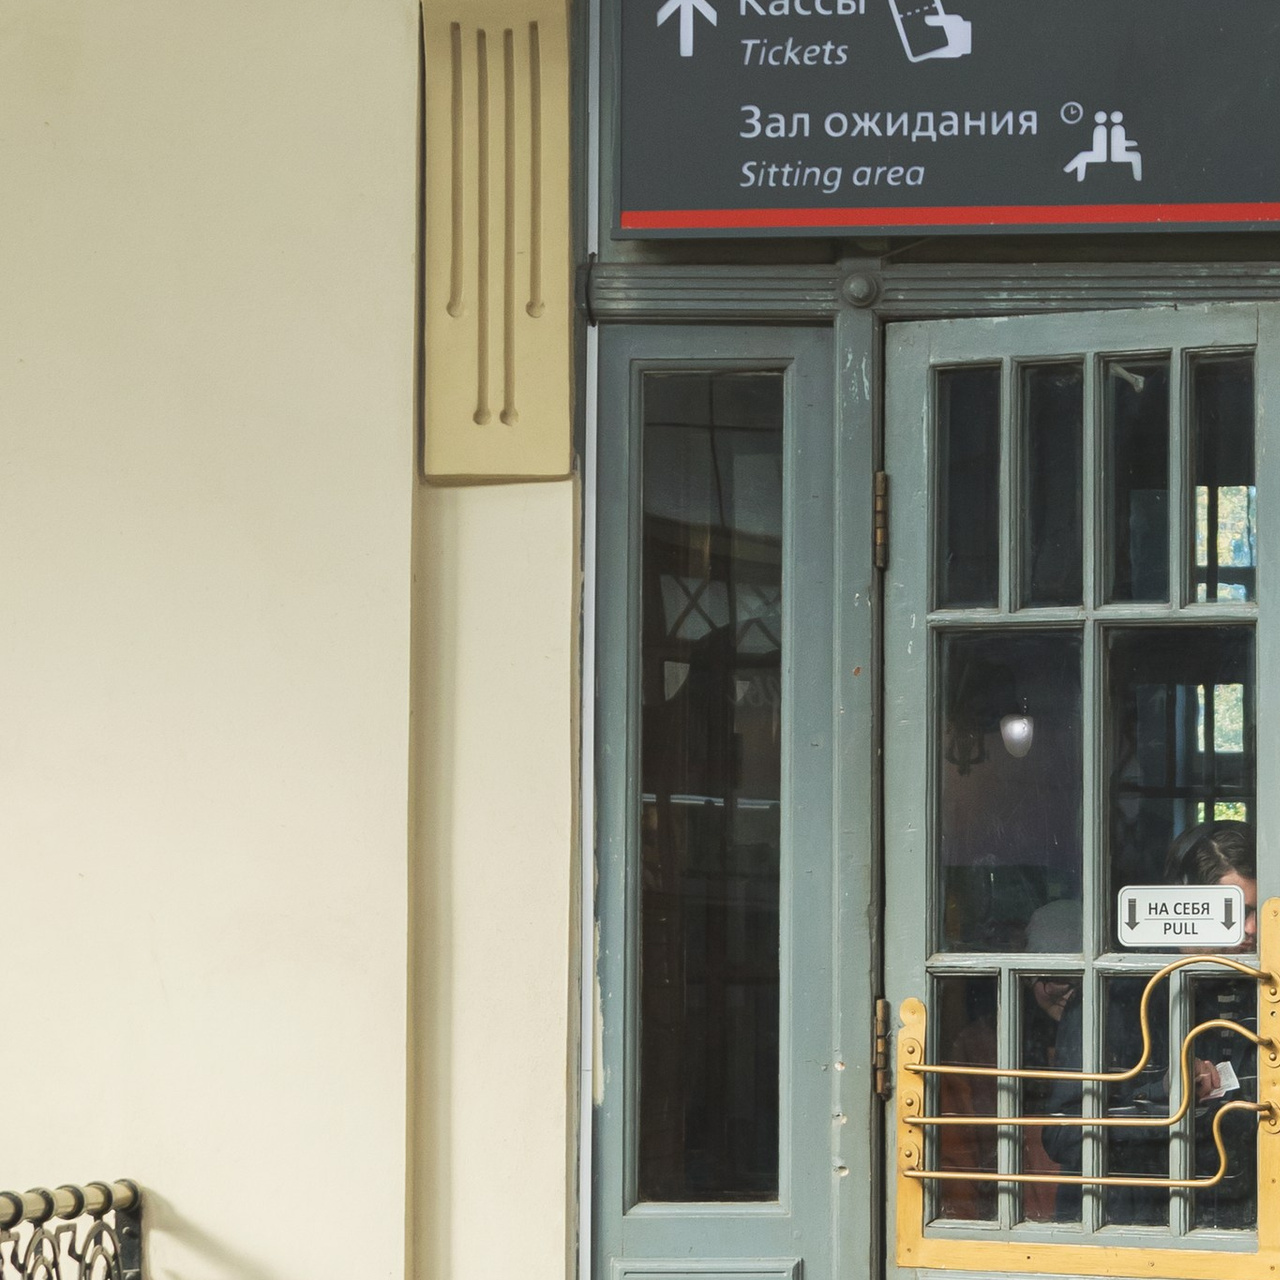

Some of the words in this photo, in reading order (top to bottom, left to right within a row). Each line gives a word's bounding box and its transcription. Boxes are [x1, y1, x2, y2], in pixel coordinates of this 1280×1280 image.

[739, 37, 849, 66] Tickets
[739, 104, 810, 139] Зал
[824, 110, 1038, 143] ожидания
[739, 160, 843, 194] Sitting
[852, 165, 925, 187] area
[1148, 902, 1170, 916] НА
[1173, 902, 1210, 916] СЕБЯ
[1163, 922, 1199, 936] PULL
